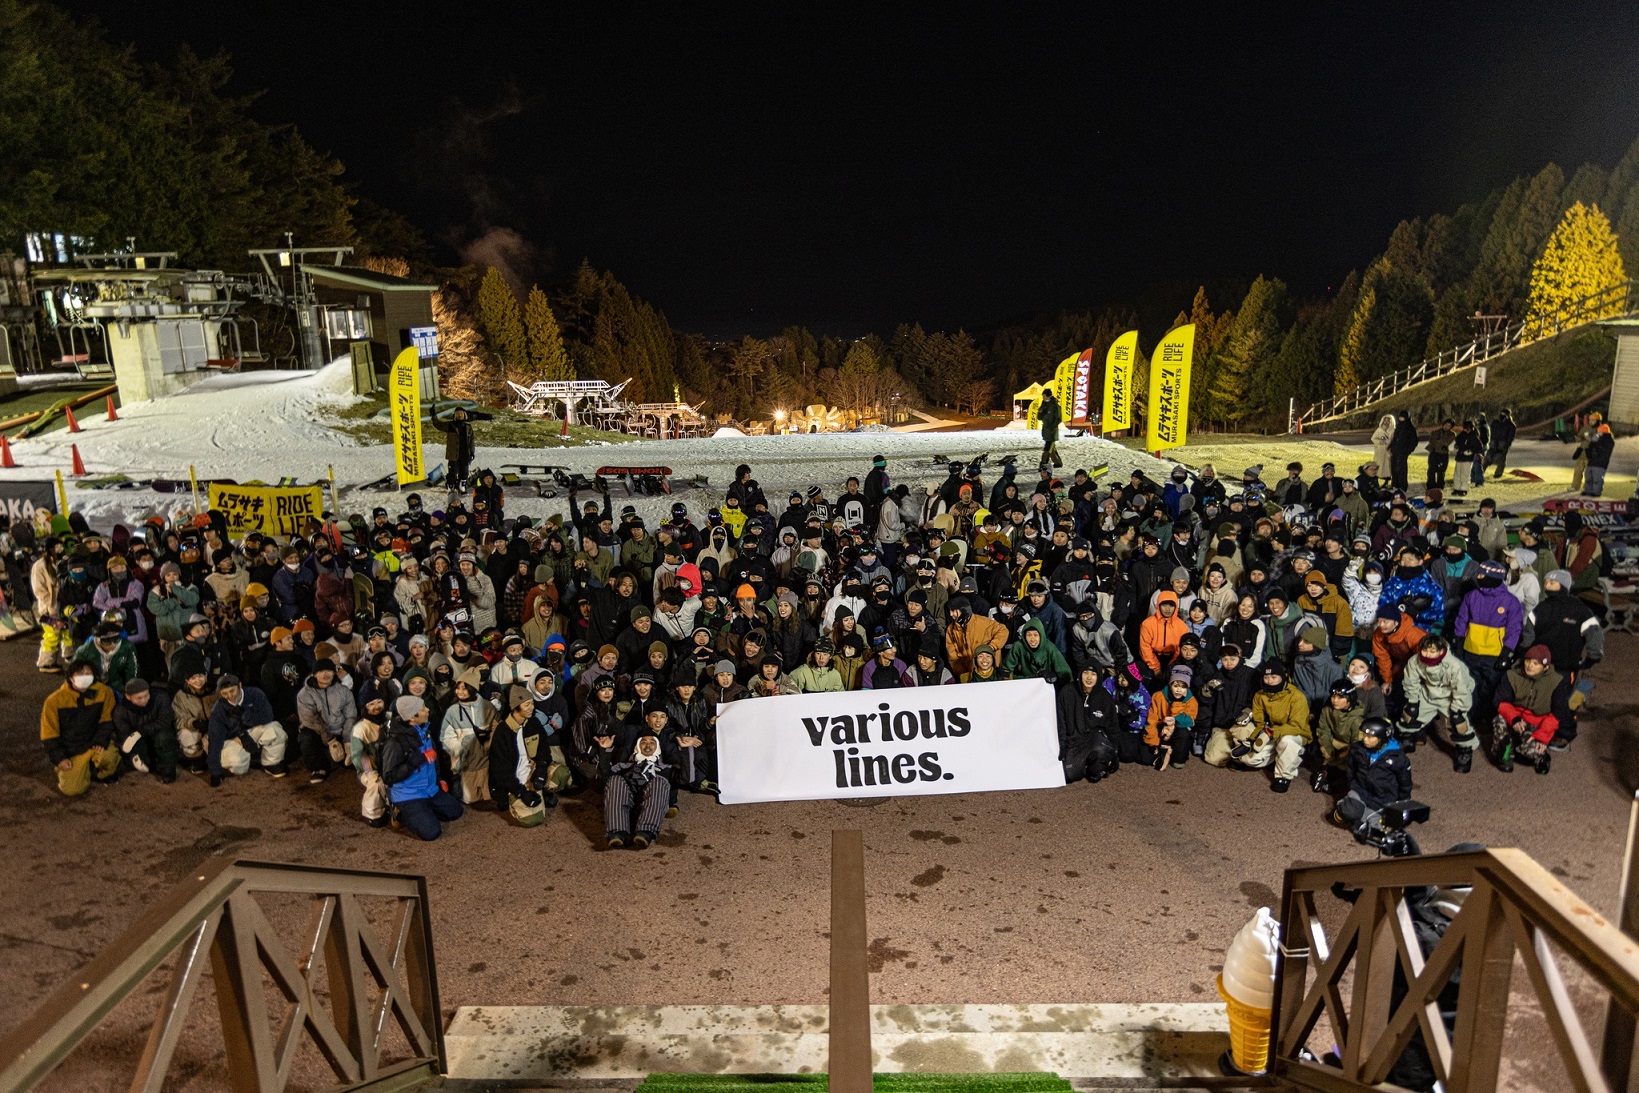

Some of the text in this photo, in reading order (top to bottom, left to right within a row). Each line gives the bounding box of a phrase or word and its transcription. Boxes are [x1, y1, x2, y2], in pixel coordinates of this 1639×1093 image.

[1163, 343, 1173, 361] RIDE
[1173, 343, 1184, 361] LIFE
[405, 366, 413, 387] LIFE
[1073, 360, 1090, 418] SPOTAKA
[1112, 365, 1123, 424] ムラサキスポーツ
[1158, 368, 1174, 442] ムラサキスポーツ
[1171, 368, 1182, 443] MURASAKI SPORTS
[399, 393, 413, 475] ムラサキスポーツ
[218, 492, 264, 509] ムラサキ
[276, 493, 314, 516] RIDE
[801, 702, 971, 746] various
[832, 747, 955, 788] lines.
